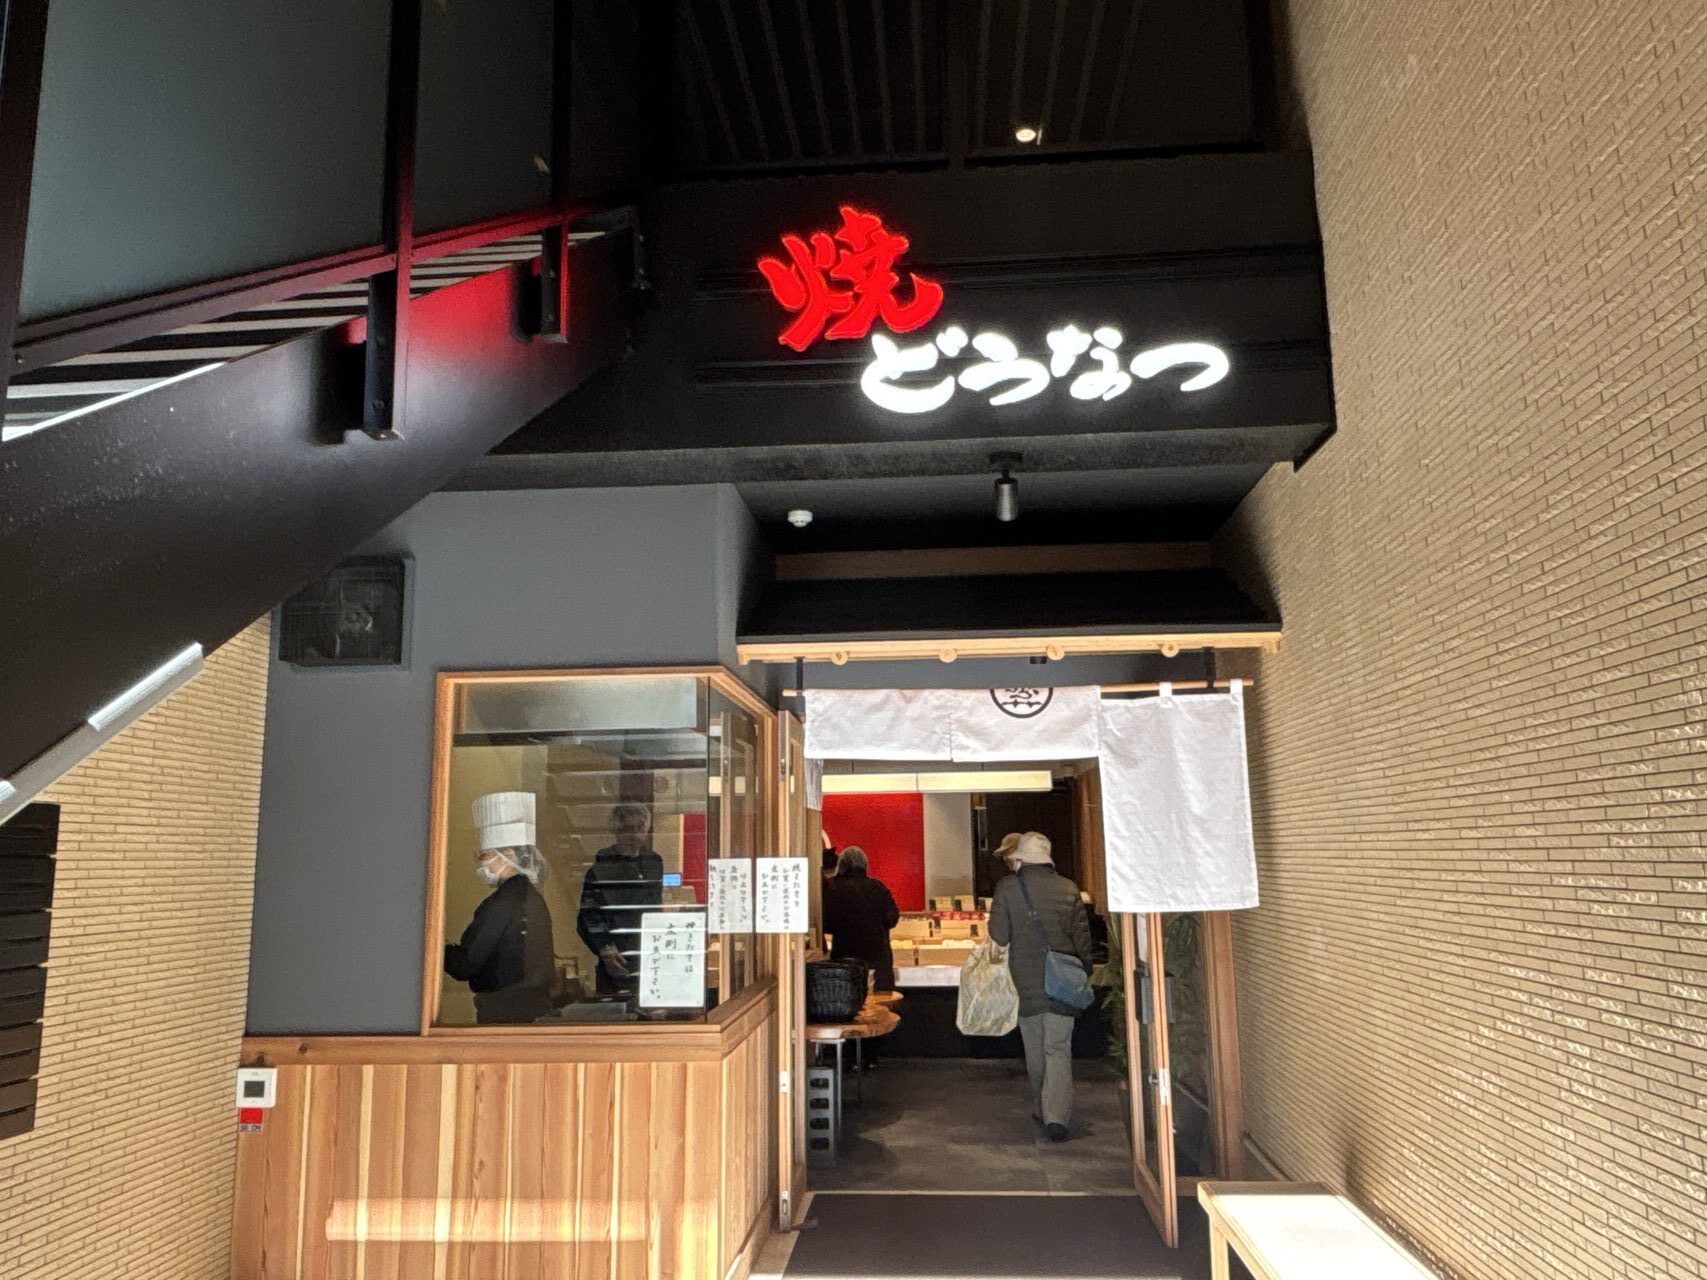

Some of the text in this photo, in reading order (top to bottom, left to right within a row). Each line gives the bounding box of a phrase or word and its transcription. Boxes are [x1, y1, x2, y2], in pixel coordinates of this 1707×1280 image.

[758, 206, 943, 351] 焼
[861, 325, 1229, 413] どうなつ
